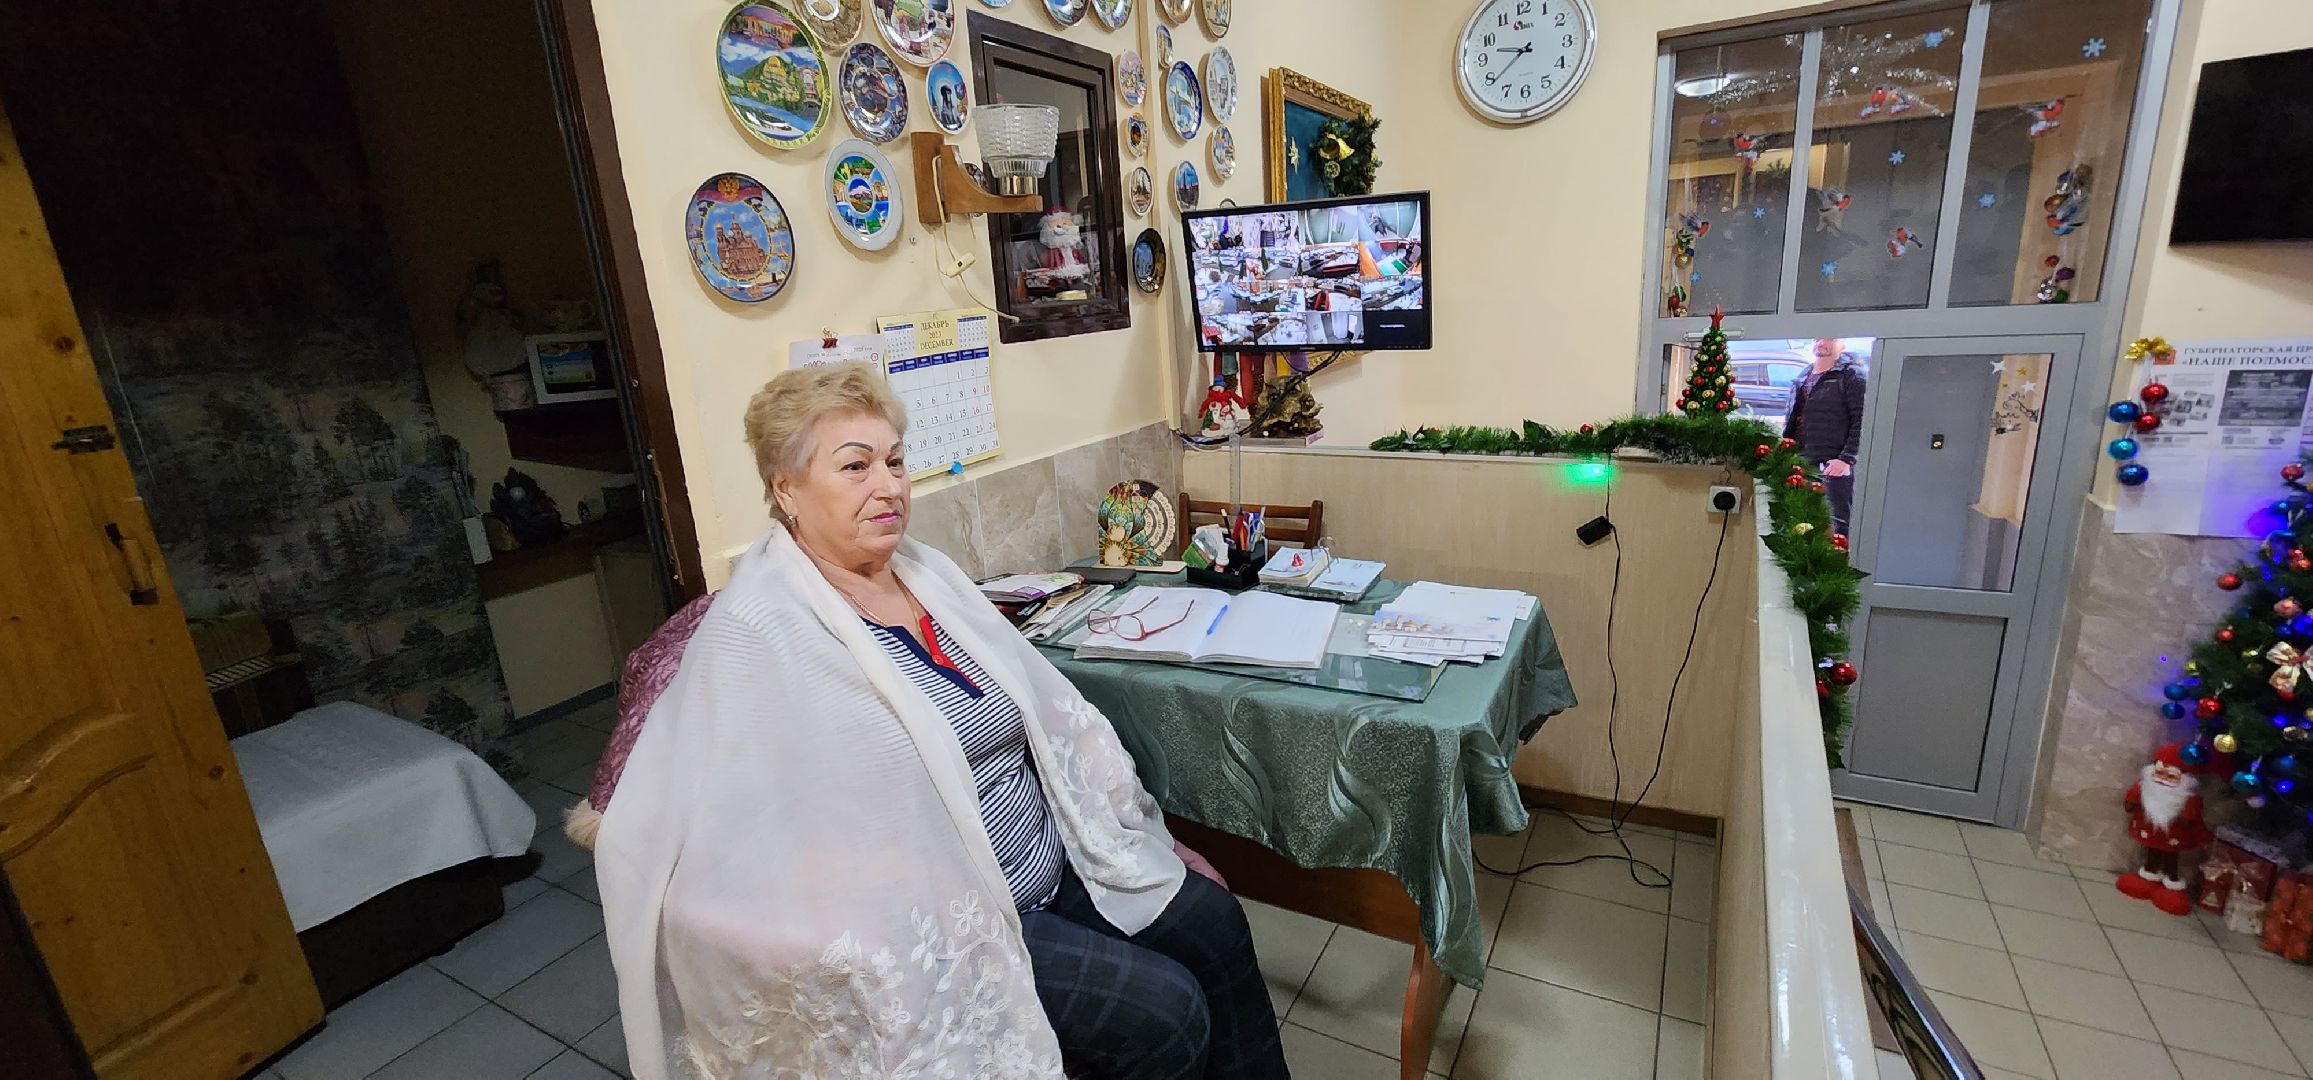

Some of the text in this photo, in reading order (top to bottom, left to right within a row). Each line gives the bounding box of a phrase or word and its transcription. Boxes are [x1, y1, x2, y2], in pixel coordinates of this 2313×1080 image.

[1516, 0, 1532, 16] 12
[1541, 1, 1549, 15] 1
[1497, 12, 1509, 27] 11
[1554, 12, 1566, 28] 2
[1483, 33, 1496, 47] 10
[1562, 34, 1573, 48] 3
[1478, 53, 1488, 67] 9
[1554, 56, 1566, 69] 4
[1485, 72, 1496, 86] 8
[1540, 74, 1551, 89] 5
[1501, 84, 1512, 98] 7
[1520, 85, 1531, 98] 6
[920, 320, 950, 332] ДЕКАБРЬ
[920, 339, 954, 350] DECEMBER
[916, 385, 990, 408] 5 6 7 8 9 10
[916, 403, 992, 429] 12 13 14 15 16 17
[905, 421, 996, 453] 18 19 20 21 22 23 24
[909, 439, 999, 473] 25 26 27 28 29 30 31
